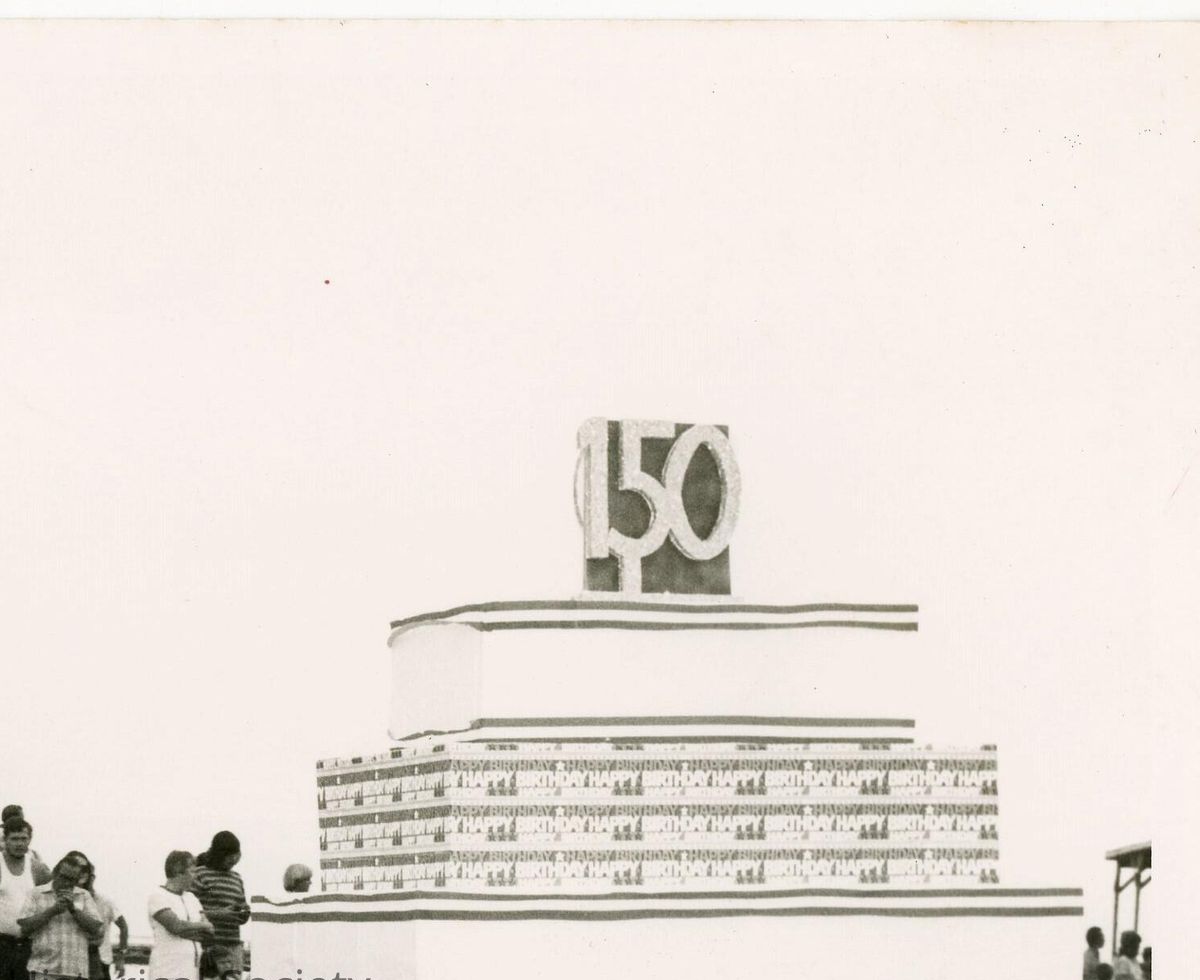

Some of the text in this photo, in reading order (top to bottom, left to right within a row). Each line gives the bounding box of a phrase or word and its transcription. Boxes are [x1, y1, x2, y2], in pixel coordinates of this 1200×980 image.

[575, 416, 742, 562] 150
[450, 759, 485, 770] APPY
[450, 805, 485, 816] APPY
[450, 850, 485, 861] APPY
